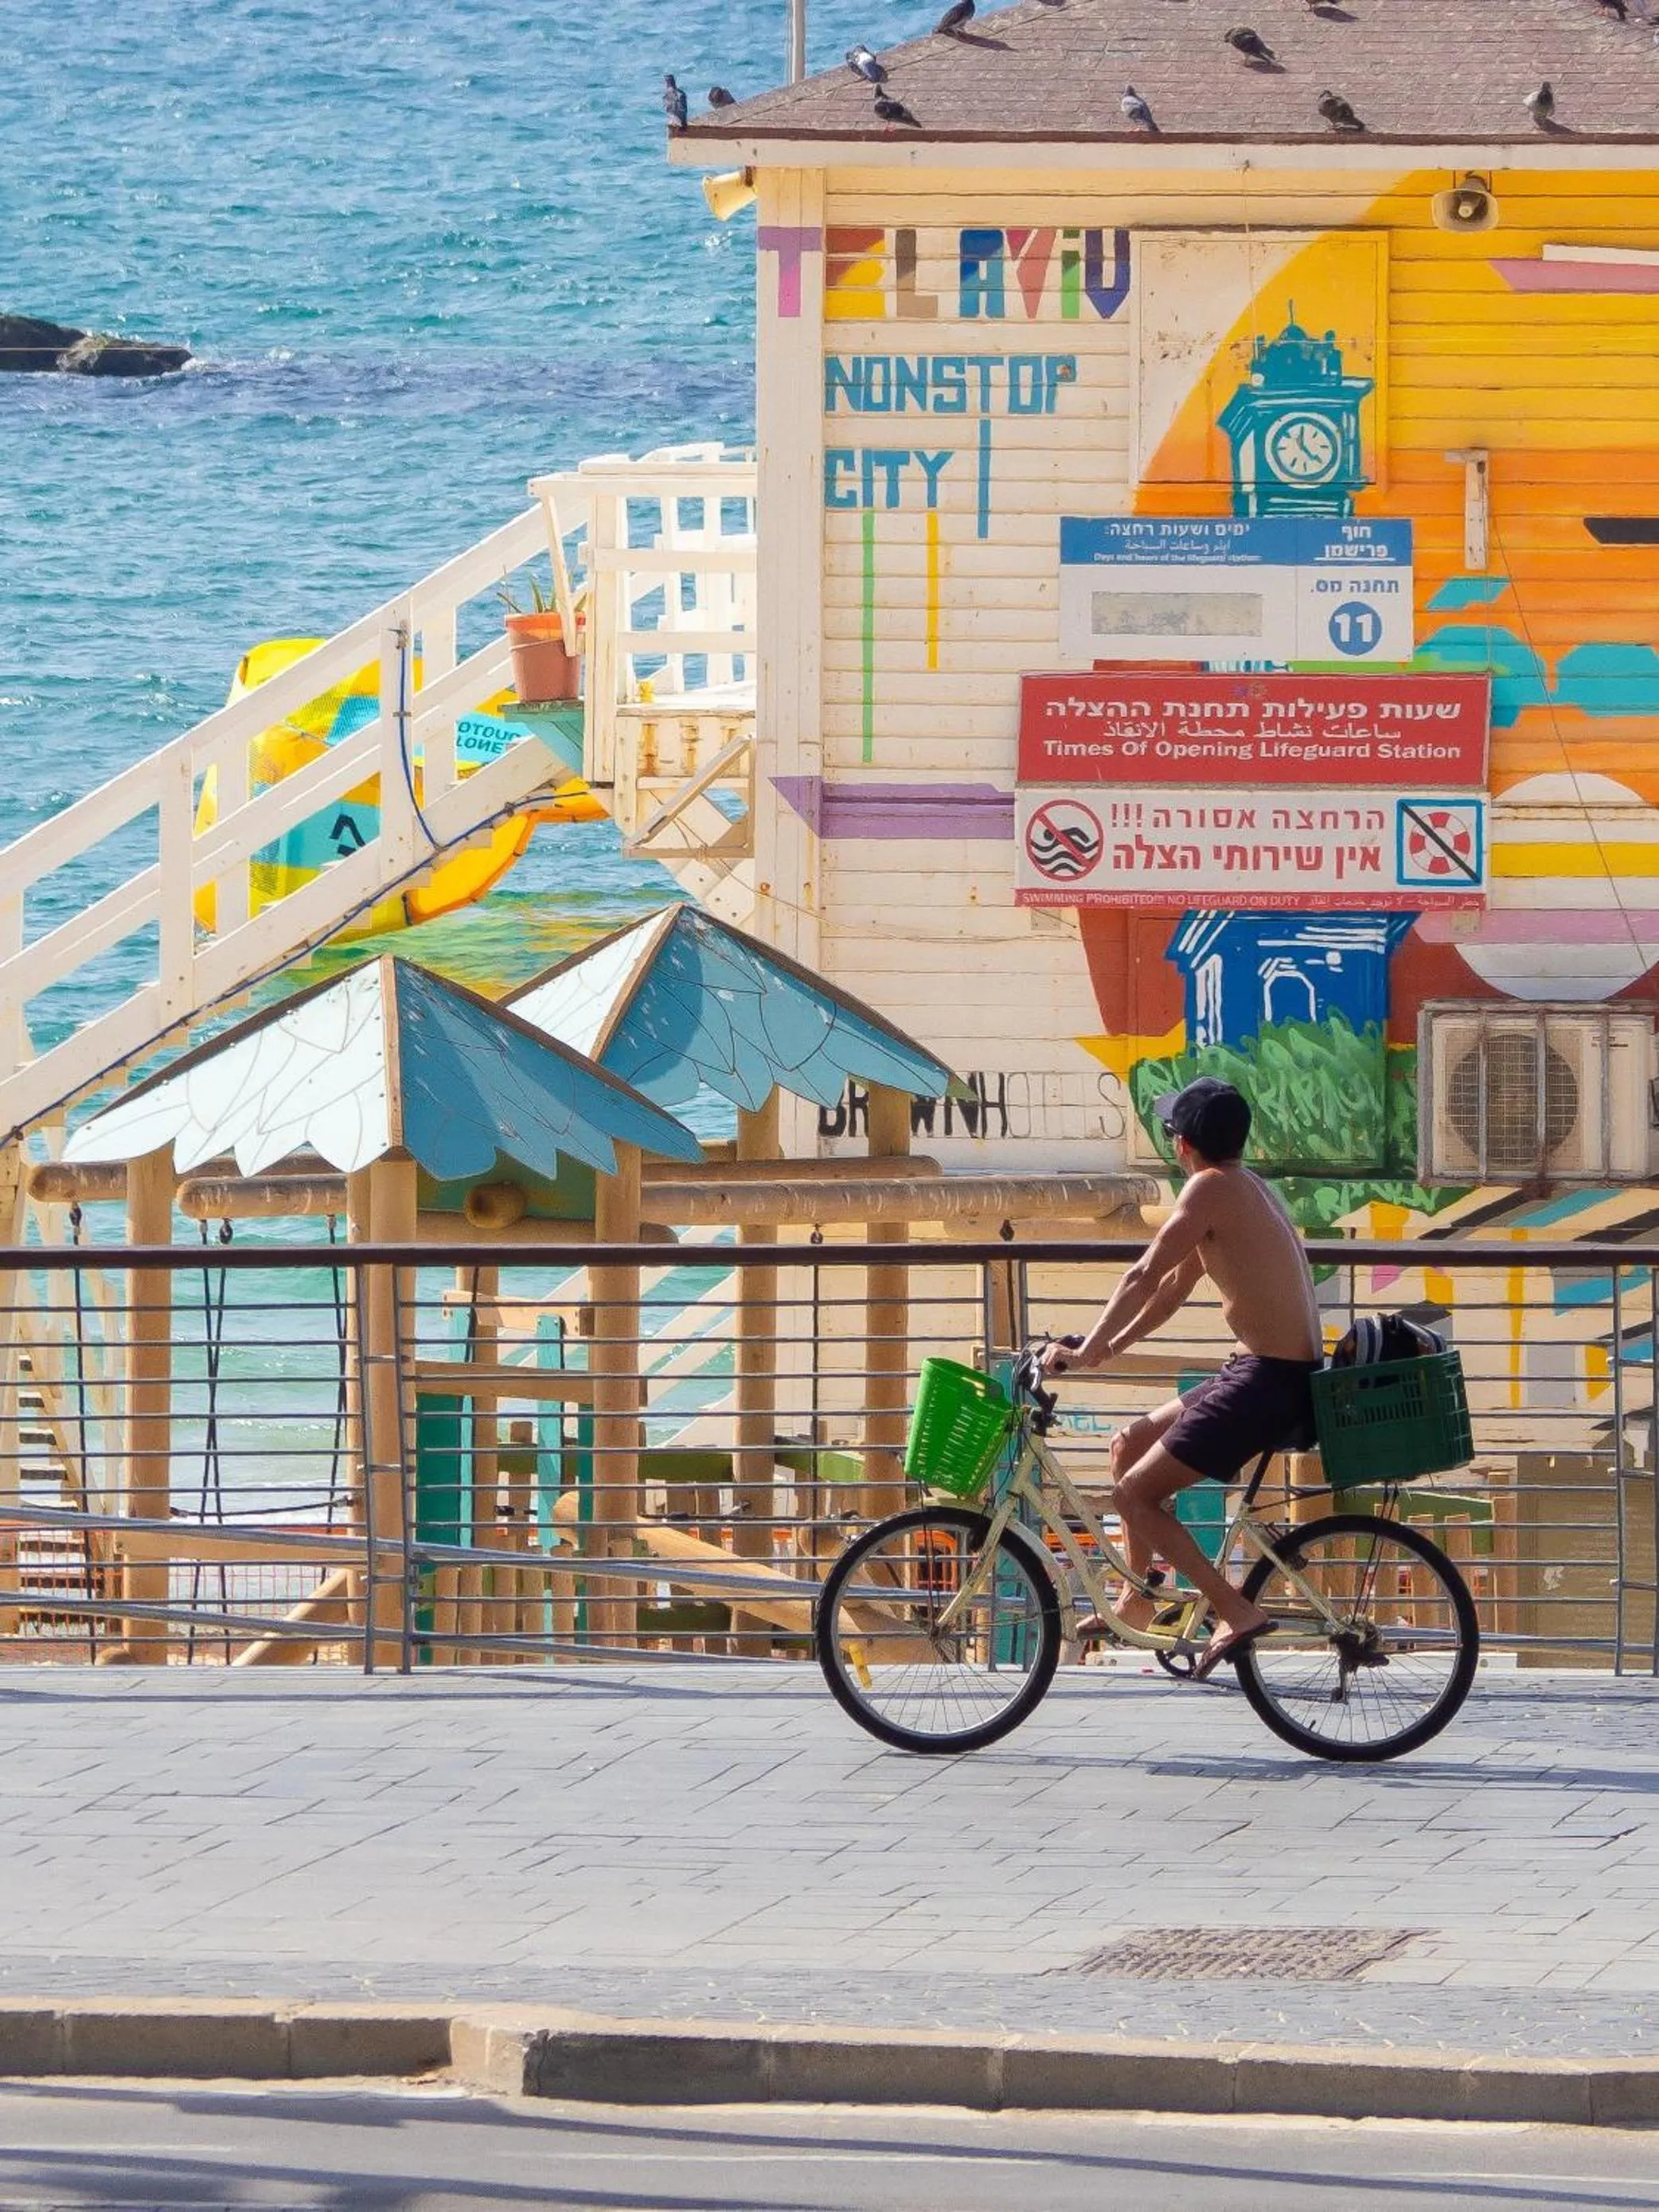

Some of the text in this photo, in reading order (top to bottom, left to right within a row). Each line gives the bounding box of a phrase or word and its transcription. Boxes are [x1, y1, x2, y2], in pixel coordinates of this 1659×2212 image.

[757, 227, 939, 318] TEL
[825, 355, 1076, 414] NONSTOP
[825, 449, 954, 509] CITY
[1159, 523, 1209, 536] ושעות
[1215, 524, 1250, 536] ימים
[1341, 525, 1372, 541] חוף
[1325, 544, 1389, 557] פרישמן
[1310, 579, 1399, 593] תחנה מס.
[1334, 613, 1372, 642] 11
[1046, 696, 1462, 720] שעות פעילות תחנת ההצלה
[1178, 720, 1245, 737] محطة
[1254, 722, 1313, 739] نشاط
[1322, 723, 1401, 739] ساعات
[1044, 739, 1461, 761] Times Of Opening Lifeguard Station
[1272, 810, 1385, 829] הרחצה
[1113, 834, 1381, 879] אין שירותי הצלה
[1023, 893, 1083, 903] SWIMMING
[1167, 894, 1185, 905] NO
[1188, 894, 1247, 906] LIFEGUARD
[1250, 895, 1268, 906] ON
[1270, 895, 1300, 906] DUTY
